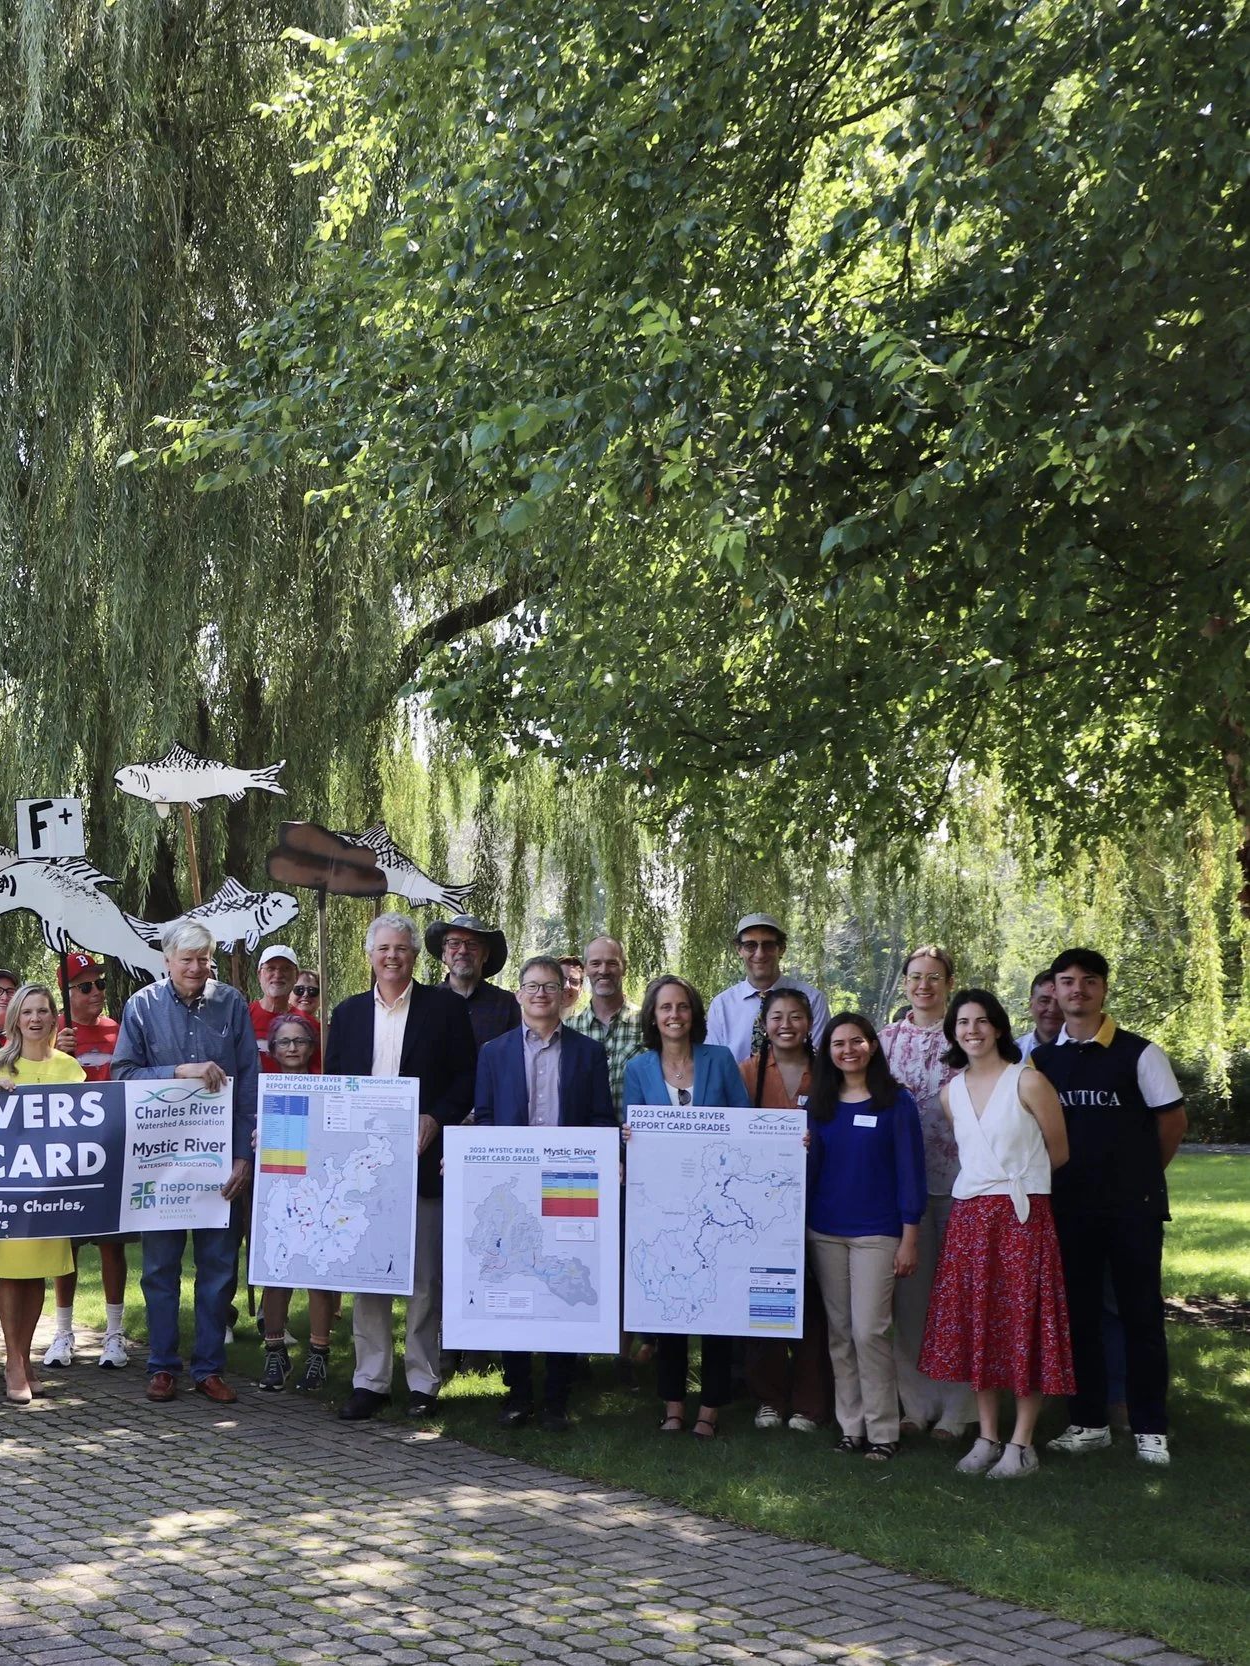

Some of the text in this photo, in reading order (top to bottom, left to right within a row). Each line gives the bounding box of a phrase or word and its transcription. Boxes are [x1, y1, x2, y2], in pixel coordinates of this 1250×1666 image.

[29, 800, 73, 849] F+
[76, 955, 89, 967] B
[284, 1075, 320, 1083] NEPONSET
[361, 1078, 394, 1086] neponset
[313, 1084, 342, 1092] GRADES
[1058, 1090, 1121, 1106] AUTICA
[134, 1102, 226, 1119] Charles River
[631, 1110, 725, 1120] 2023 CHARLES RIVER
[136, 1118, 225, 1130] Watershed Association
[630, 1122, 731, 1132] REPORT CARD GRADES
[132, 1138, 227, 1157] Mystic River
[543, 1147, 597, 1157] Mystic River
[138, 1161, 173, 1170] WATERSHED
[159, 1182, 225, 1193] neponset
[159, 1194, 191, 1205] river
[23, 1198, 86, 1213] Charles,
